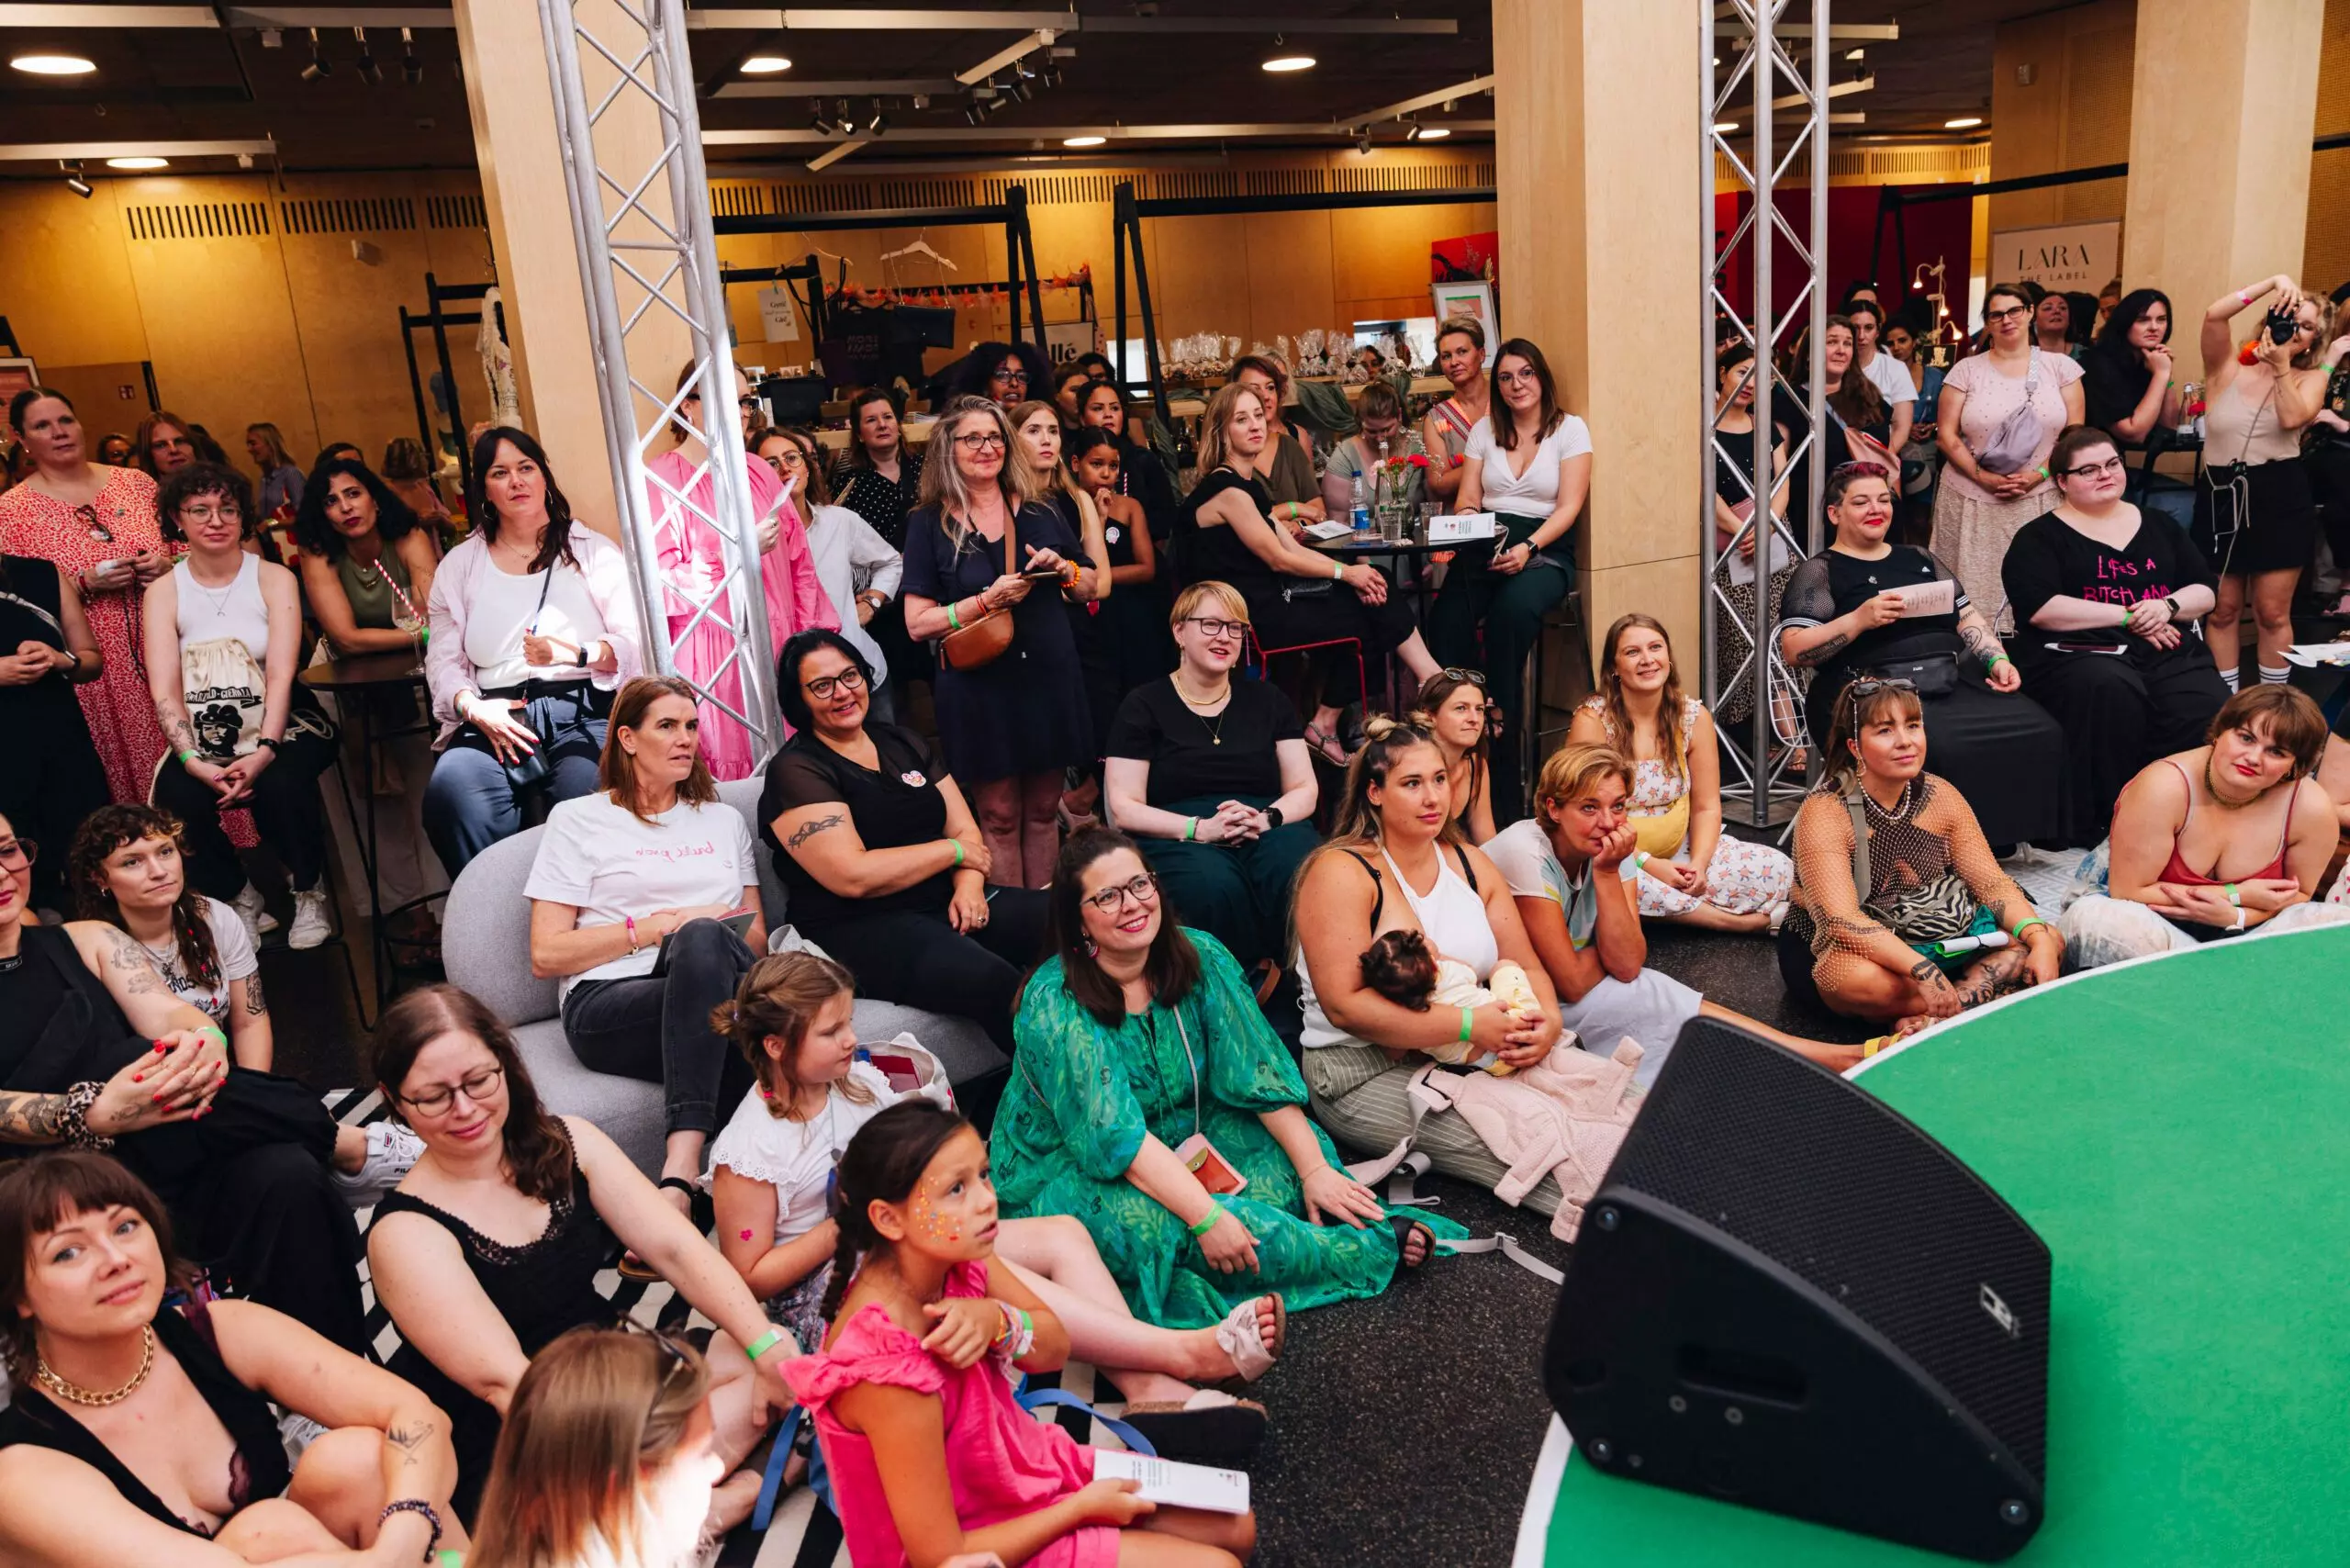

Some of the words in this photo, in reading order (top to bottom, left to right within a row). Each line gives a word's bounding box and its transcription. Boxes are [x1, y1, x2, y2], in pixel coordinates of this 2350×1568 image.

[2019, 244, 2090, 271] LARA
[2019, 274, 2042, 283] THE
[2049, 271, 2087, 282] LABEL
[2145, 558, 2156, 570] A
[2083, 585, 2136, 605] BITCH
